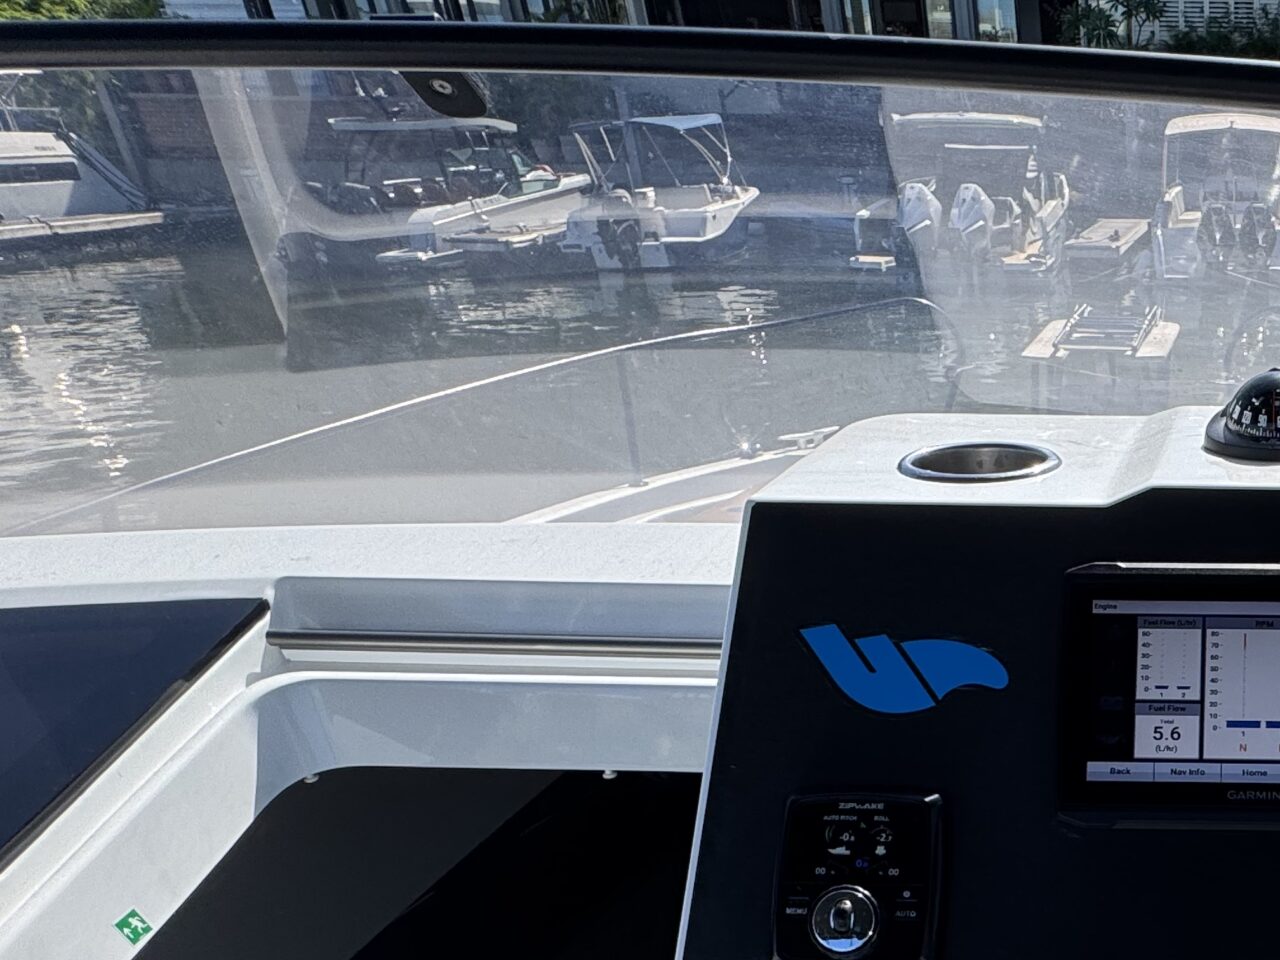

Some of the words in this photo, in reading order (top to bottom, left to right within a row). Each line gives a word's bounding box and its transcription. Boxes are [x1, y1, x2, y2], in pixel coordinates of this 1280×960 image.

[1094, 603, 1118, 611] Engine
[1153, 726, 1181, 741] 5.6
[1155, 745, 1178, 753] (L/hr)
[1239, 743, 1248, 752] N
[1109, 767, 1131, 776] Back
[1170, 768, 1187, 776] Nav
[1188, 768, 1206, 776] Info
[1242, 769, 1268, 777] Home
